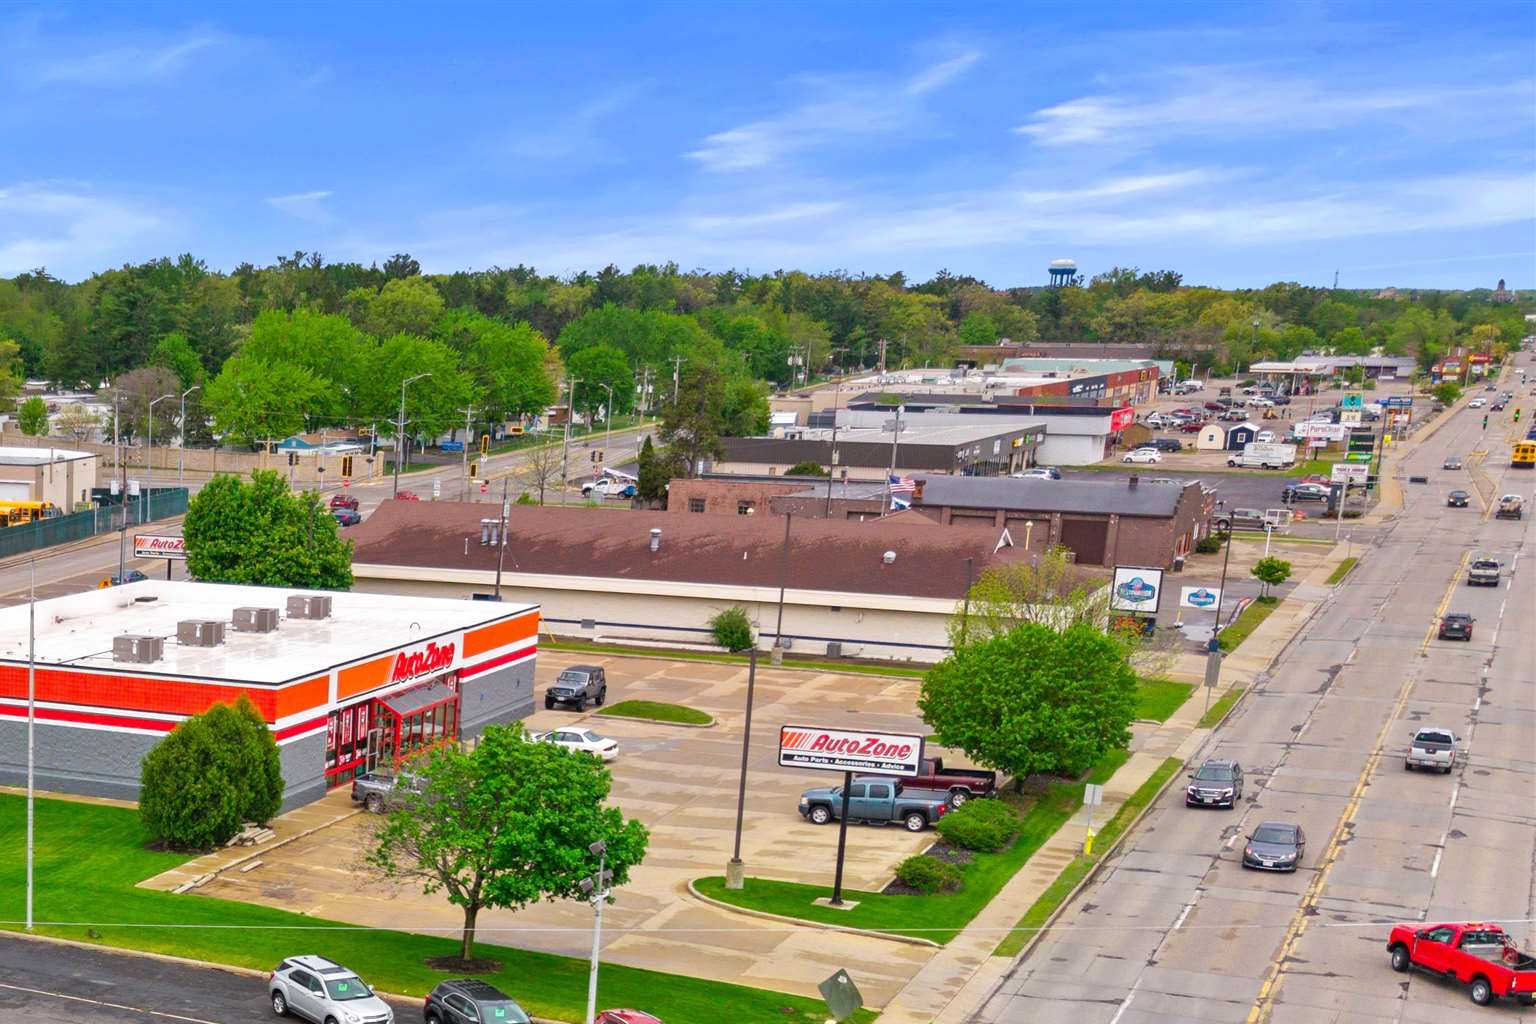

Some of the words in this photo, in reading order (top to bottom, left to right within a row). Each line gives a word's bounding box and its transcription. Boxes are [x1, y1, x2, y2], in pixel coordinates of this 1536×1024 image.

[392, 642, 455, 682] AutoZone
[810, 734, 912, 759] AutoZone
[882, 762, 905, 770] Advice
